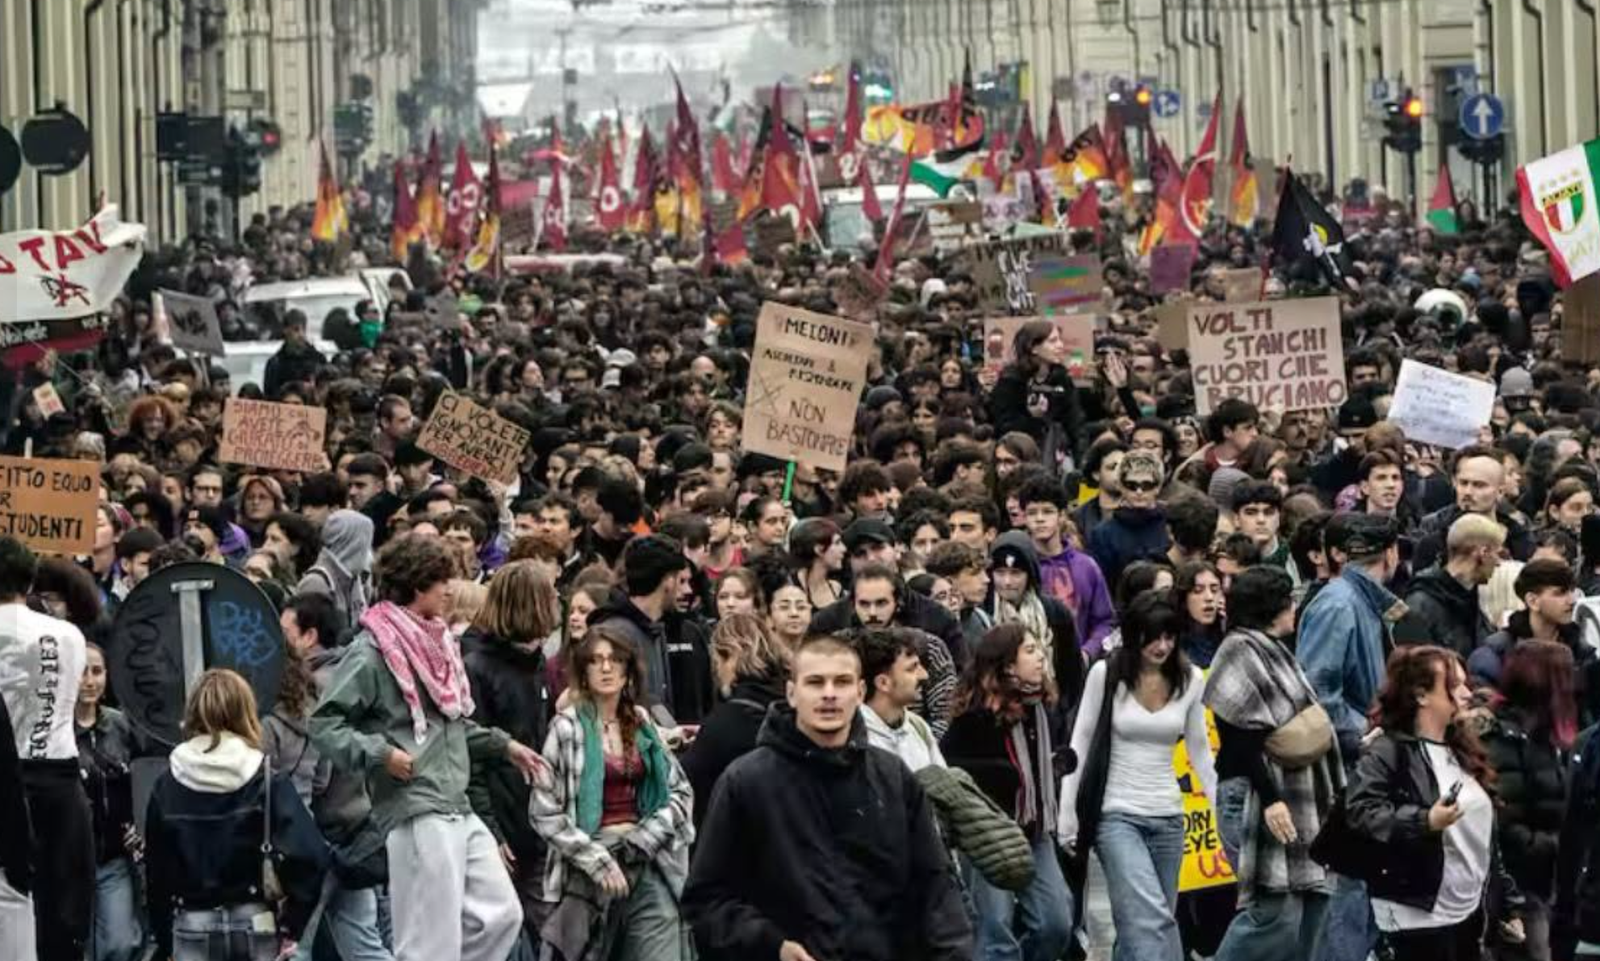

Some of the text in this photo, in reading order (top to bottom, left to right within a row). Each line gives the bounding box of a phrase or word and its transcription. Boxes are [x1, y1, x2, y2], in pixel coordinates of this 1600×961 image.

[18, 220, 108, 270] TAV
[1194, 308, 1273, 336] VOLTI
[1223, 328, 1326, 360] STANCHI
[1194, 353, 1329, 385] CUORI CHE
[442, 394, 459, 413] CI
[789, 398, 826, 423] NON
[426, 422, 454, 444] PER
[468, 407, 528, 446] VOLETE
[52, 471, 91, 493] EQUO
[0, 511, 82, 541] STUDENTI
[1198, 850, 1233, 878] US
